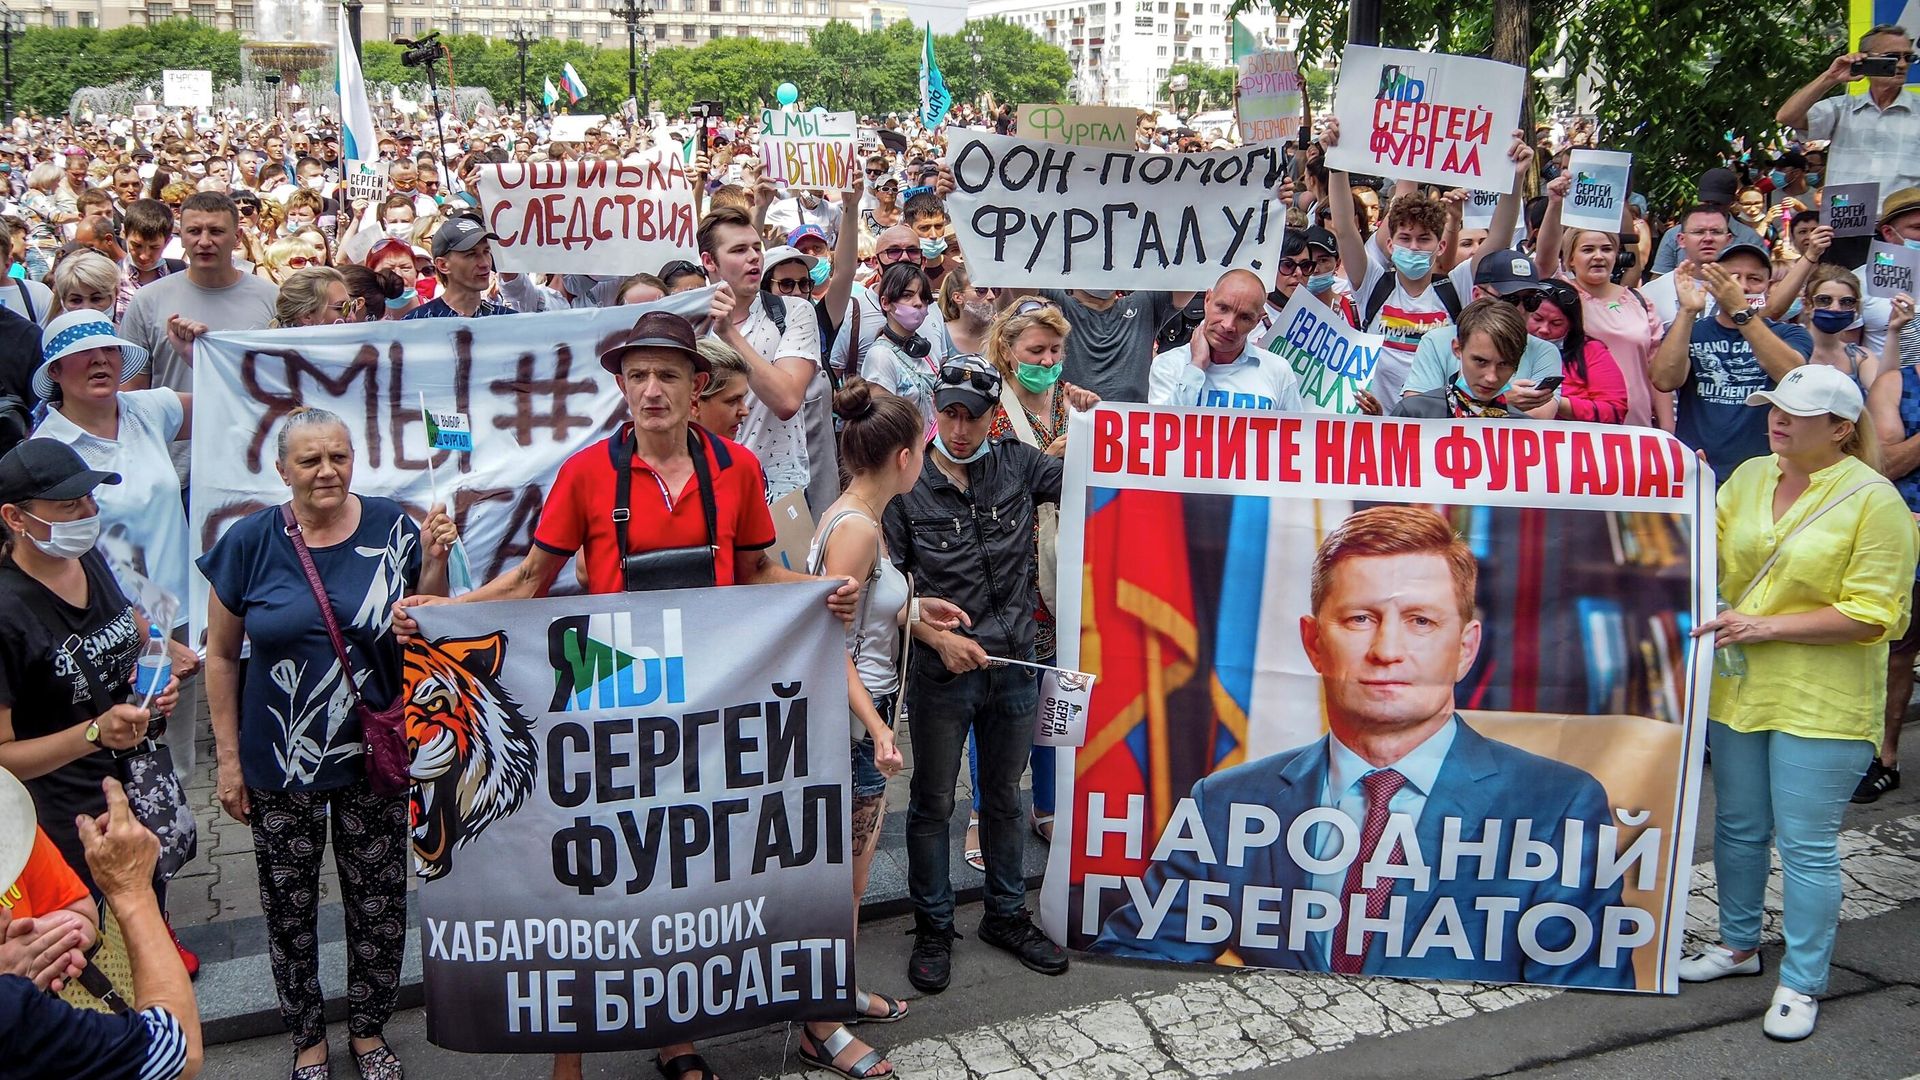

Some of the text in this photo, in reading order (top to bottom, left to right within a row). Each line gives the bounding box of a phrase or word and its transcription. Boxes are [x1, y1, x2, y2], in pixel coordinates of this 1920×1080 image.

[1372, 99, 1493, 144] СЕРГЕЙ
[764, 141, 855, 188] ЦВЕТКОВА
[1370, 129, 1481, 176] ФУРГАЛ
[350, 174, 383, 187] СЕРГЕЙ
[350, 187, 383, 200] ФУРГАЛ
[1474, 195, 1500, 206] ФУРГ
[1576, 183, 1612, 197] СЕРГЕЙ
[490, 194, 694, 251] СЛЕДСТВИЯ
[1575, 195, 1613, 209] ФУРГАЛ
[1831, 203, 1865, 218] СЕРГЕЙ
[1831, 216, 1867, 229] ФУРГАЛ
[971, 200, 1270, 275] ФУРГАЛУ!
[1873, 276, 1914, 293] ФУРГАЛ
[1874, 264, 1911, 280] СЕРГЕЙ
[1286, 307, 1382, 381] СВОБОДУ
[1689, 340, 1752, 356] GRAND CA
[440, 414, 460, 429] ВЫБОР
[1092, 408, 1685, 499] ВЕРНИТЕ НАМ ФУРГАЛА!
[1041, 697, 1056, 737] ФУРГАЛ
[1053, 700, 1069, 735] СЕРГЕЙ
[546, 681, 809, 808] СЕРГЕЙ
[551, 784, 843, 896] ФУРГАЛ
[1084, 791, 1661, 892] НАРОДНЫЙ
[426, 895, 767, 962] ХАБАРОВСК СВОИХ
[1081, 873, 1656, 969] ГУБЕРНАТОР
[506, 938, 848, 1033] НЕ БРОСАЕТ!
